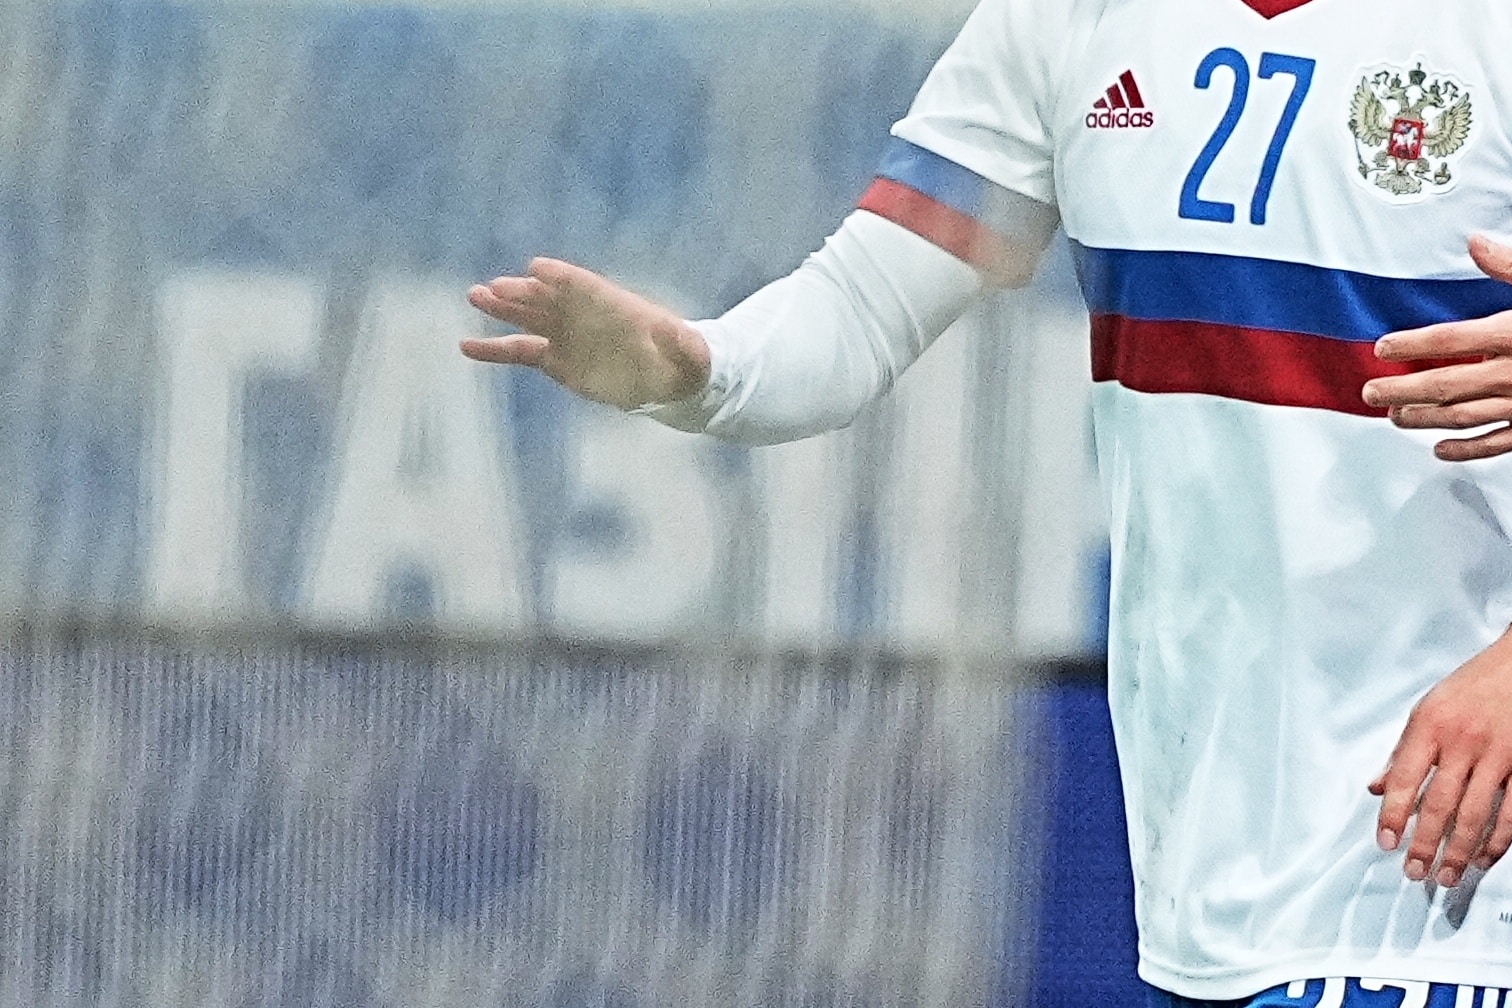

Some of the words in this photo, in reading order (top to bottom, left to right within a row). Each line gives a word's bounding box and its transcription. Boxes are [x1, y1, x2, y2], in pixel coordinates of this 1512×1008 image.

[1085, 107, 1154, 128] adidas
[1178, 47, 1316, 225] 27
[146, 272, 1110, 652] ГАЗП
